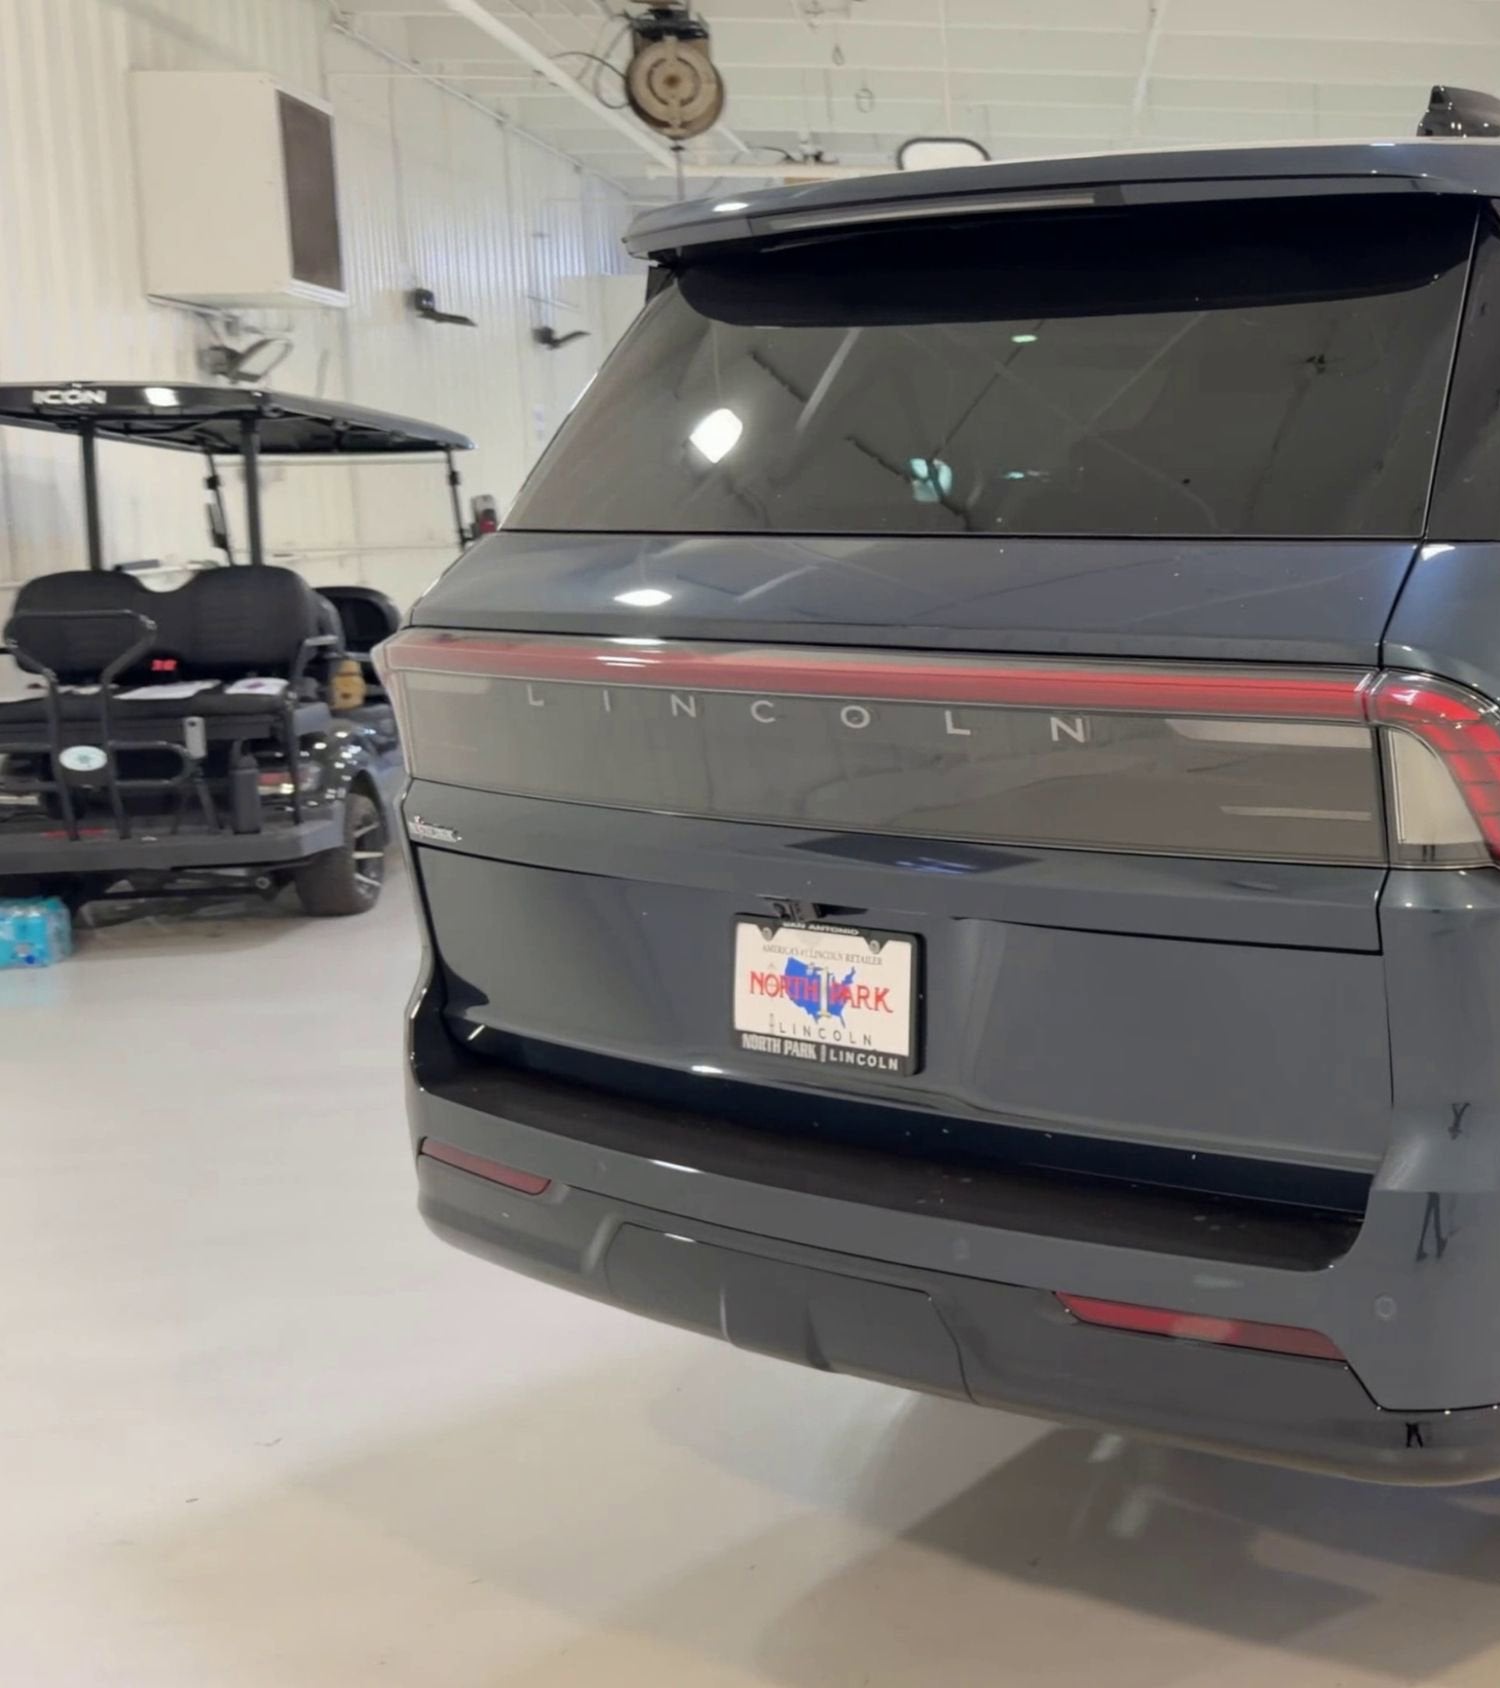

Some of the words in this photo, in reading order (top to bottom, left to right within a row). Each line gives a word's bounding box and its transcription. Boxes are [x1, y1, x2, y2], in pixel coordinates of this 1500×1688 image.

[32, 389, 107, 404] ICON
[528, 684, 1086, 743] LINCOLN
[845, 953, 882, 966] RETAILER
[749, 970, 819, 1003] NORTH
[831, 980, 894, 1014] PARK
[779, 1022, 872, 1047] LINCOLN
[742, 1033, 783, 1054] NORTH
[784, 1040, 817, 1061] PARK
[829, 1051, 899, 1071] LINCOLN
